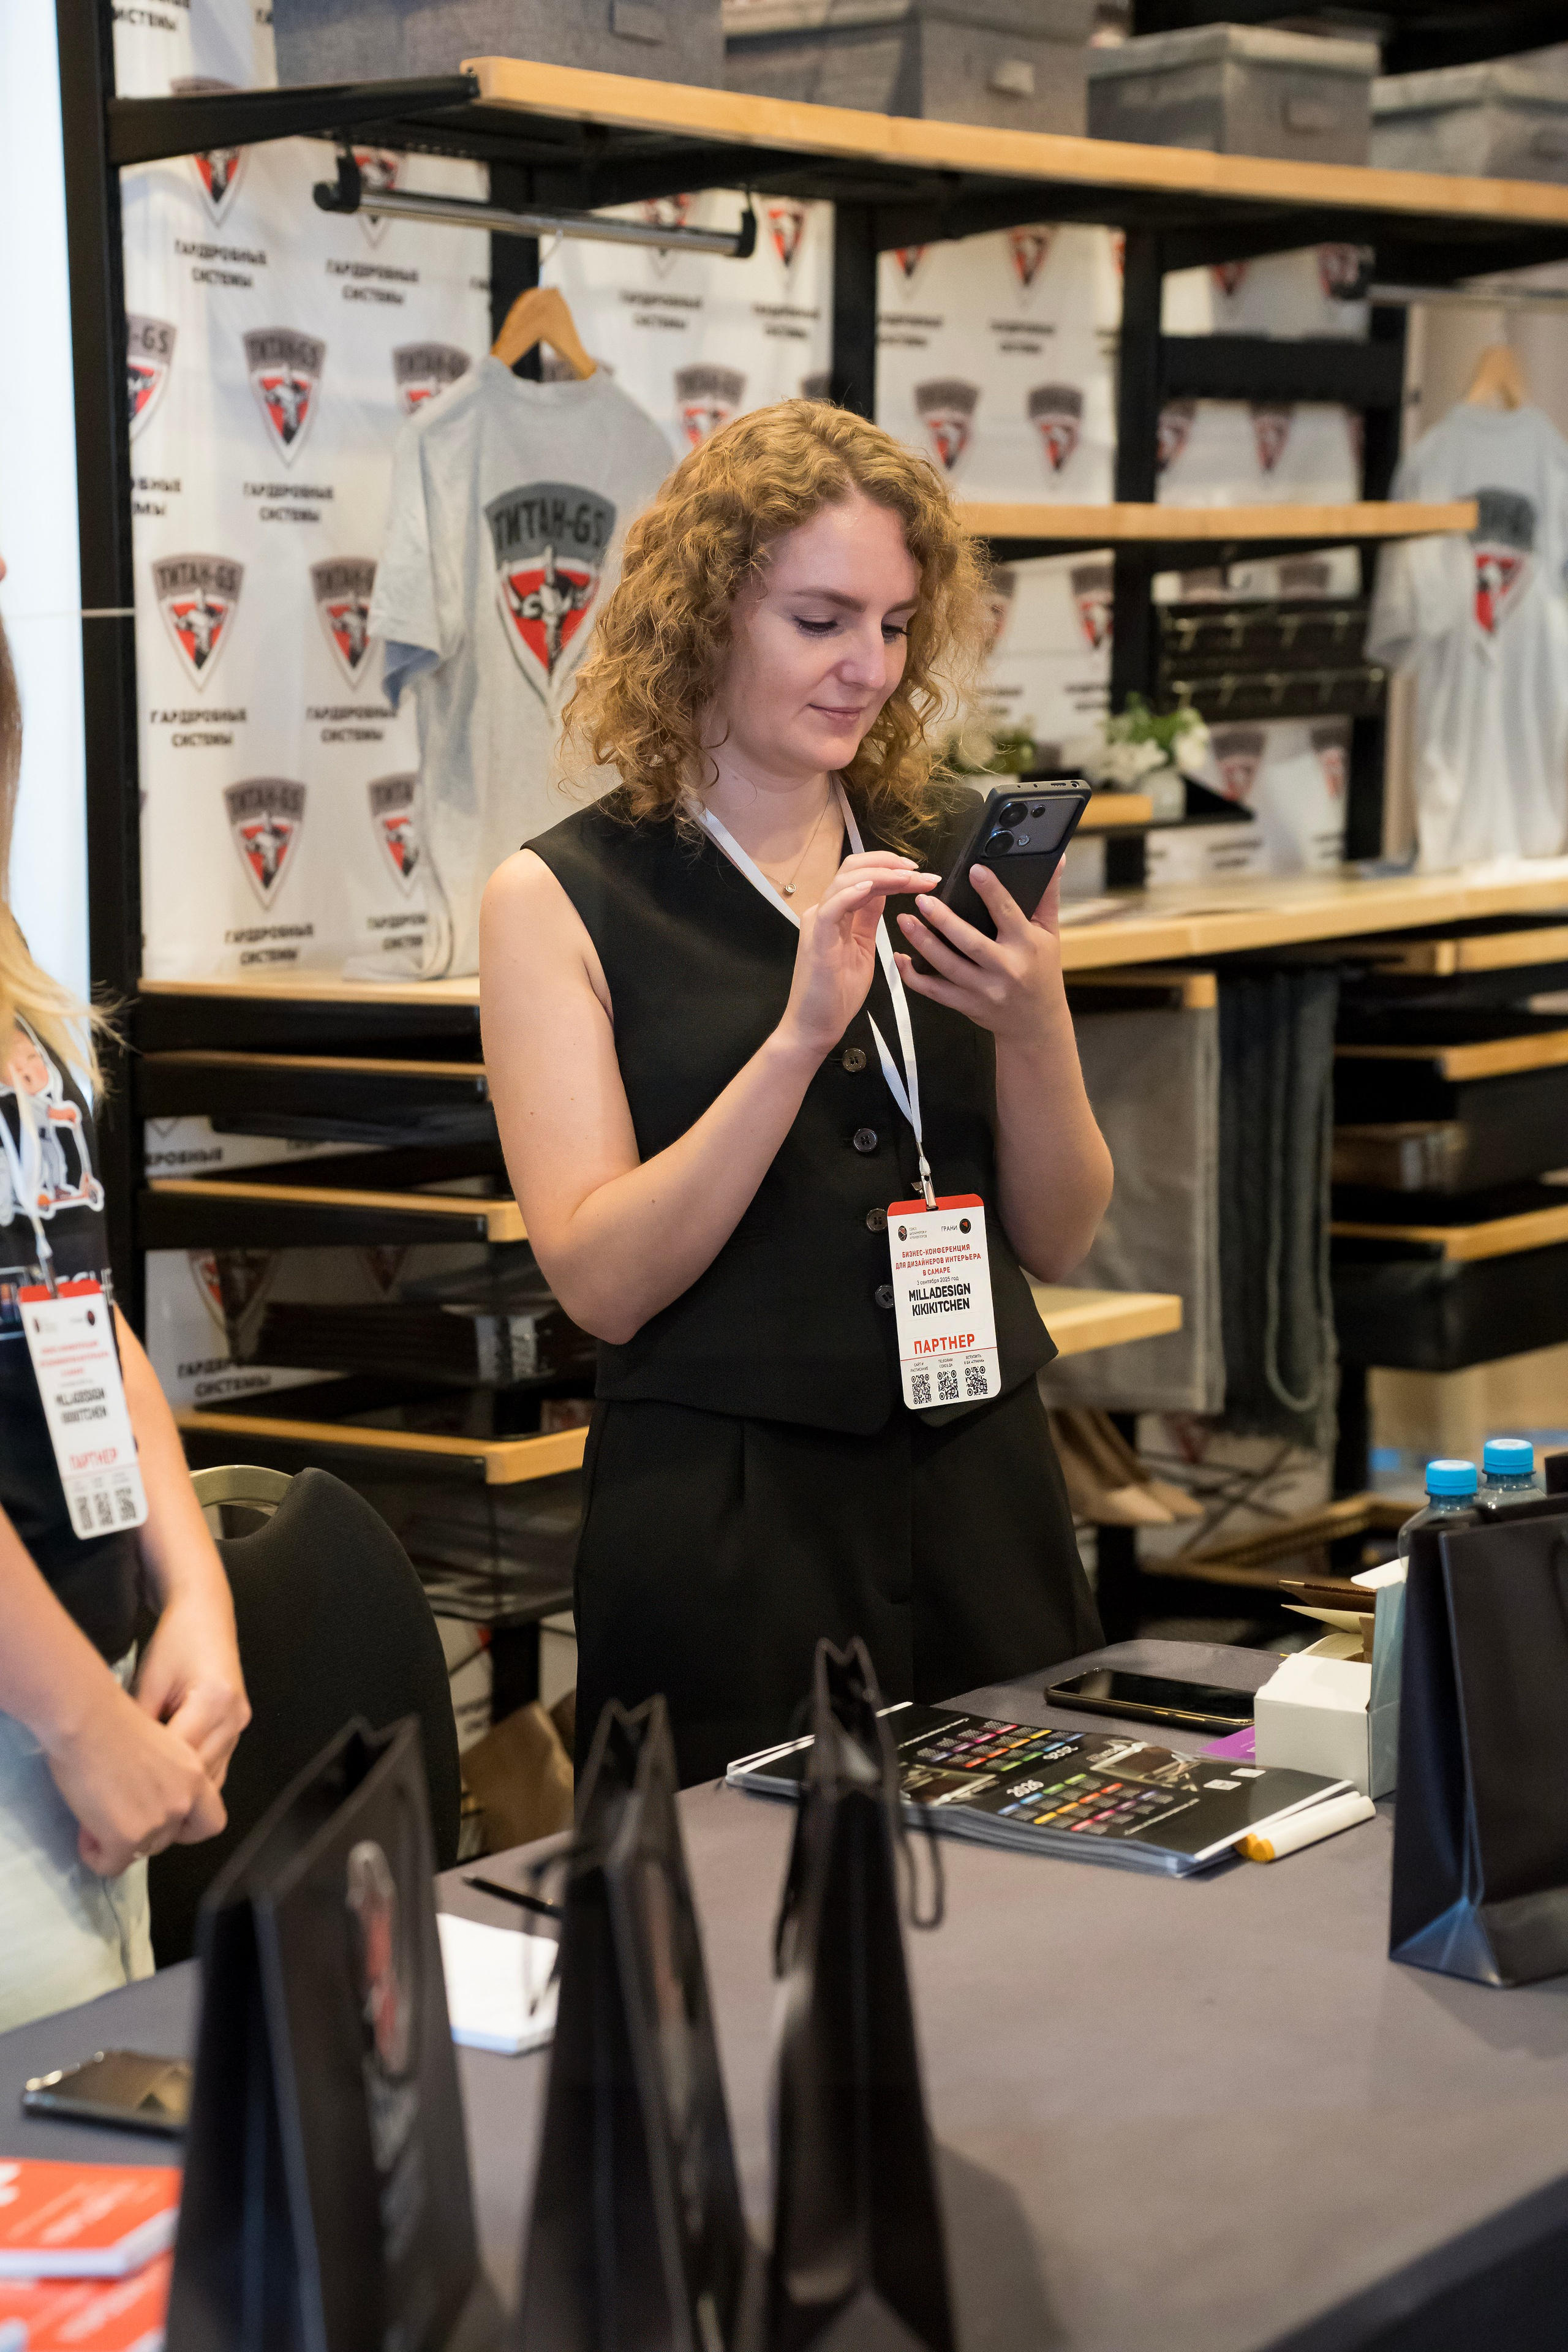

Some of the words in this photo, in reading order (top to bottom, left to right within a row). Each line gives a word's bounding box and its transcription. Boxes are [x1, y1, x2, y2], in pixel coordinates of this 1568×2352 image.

[902, 1244, 970, 1258] БИЗНЕС-КОНФЕРЕНЦИЯ
[907, 1257, 944, 1268] ДИЗАЙНЕРОВ
[946, 1253, 981, 1263] ИНТЕРЬЕРА
[927, 1267, 951, 1276] САМАРЕ
[908, 1283, 971, 1302] MILLADESIGN
[912, 1297, 970, 1316] KIKIKITCHEN
[914, 1333, 975, 1354] ПАРТНЕР
[1006, 1779, 1044, 1798] 2026
